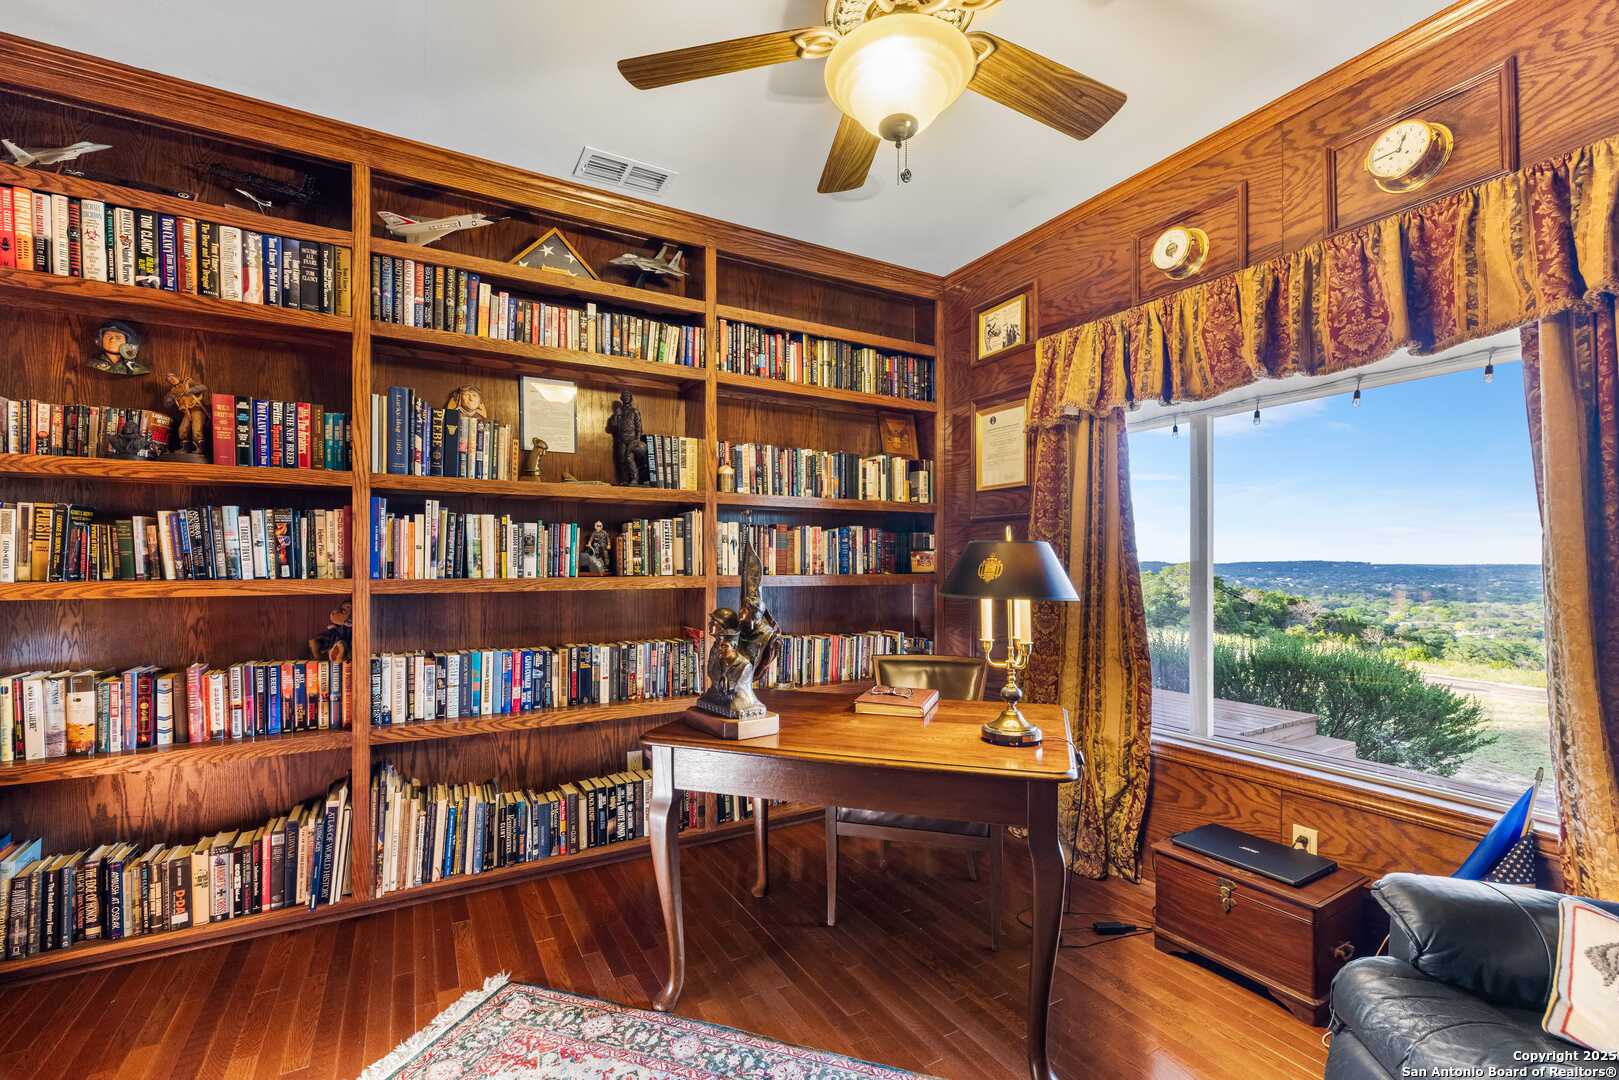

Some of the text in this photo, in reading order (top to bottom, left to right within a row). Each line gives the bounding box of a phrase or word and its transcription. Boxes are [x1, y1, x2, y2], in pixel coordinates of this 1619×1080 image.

[141, 215, 153, 256] TOM CLANCY
[273, 401, 283, 424] Griffin
[433, 409, 442, 447] PLEBE
[271, 425, 282, 449] Special
[287, 444, 295, 465] BREED
[616, 804, 626, 838] WHITE NINJA
[320, 811, 335, 899] ATLAS OF WORLD HISTORY
[11, 889, 27, 918] AVIATORS
[85, 868, 97, 924] THE EDGE OF HONOR
[111, 872, 120, 930] AMBUSH AT OSIRAK
[175, 889, 186, 915] D-DA
[46, 903, 54, 922] Anthony
